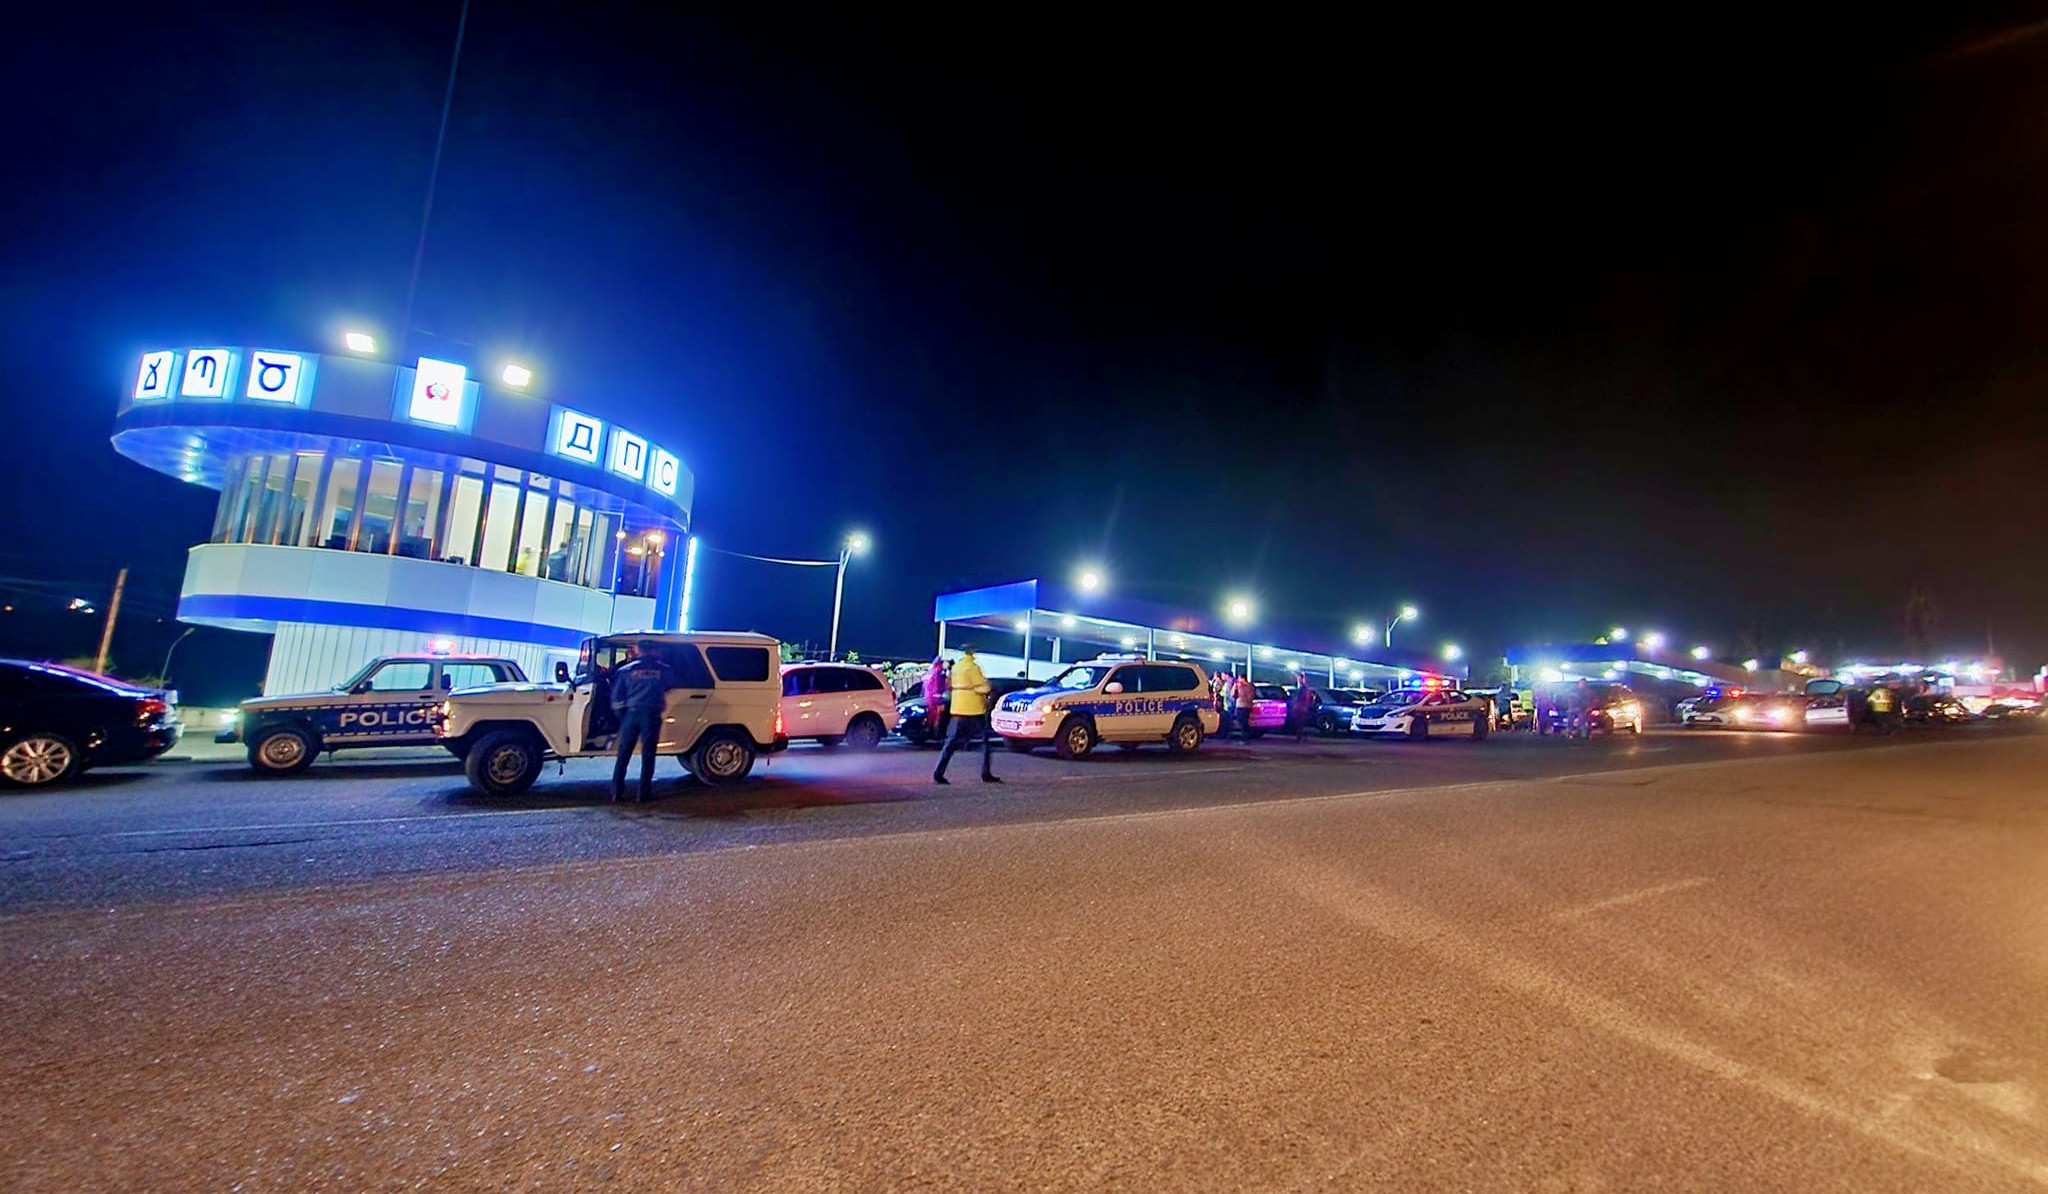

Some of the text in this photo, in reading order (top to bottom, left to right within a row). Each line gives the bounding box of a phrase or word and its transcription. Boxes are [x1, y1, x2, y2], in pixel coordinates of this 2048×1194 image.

[566, 422, 673, 487] ДПС
[1116, 700, 1164, 713] POLICE
[340, 711, 438, 727] POLICE
